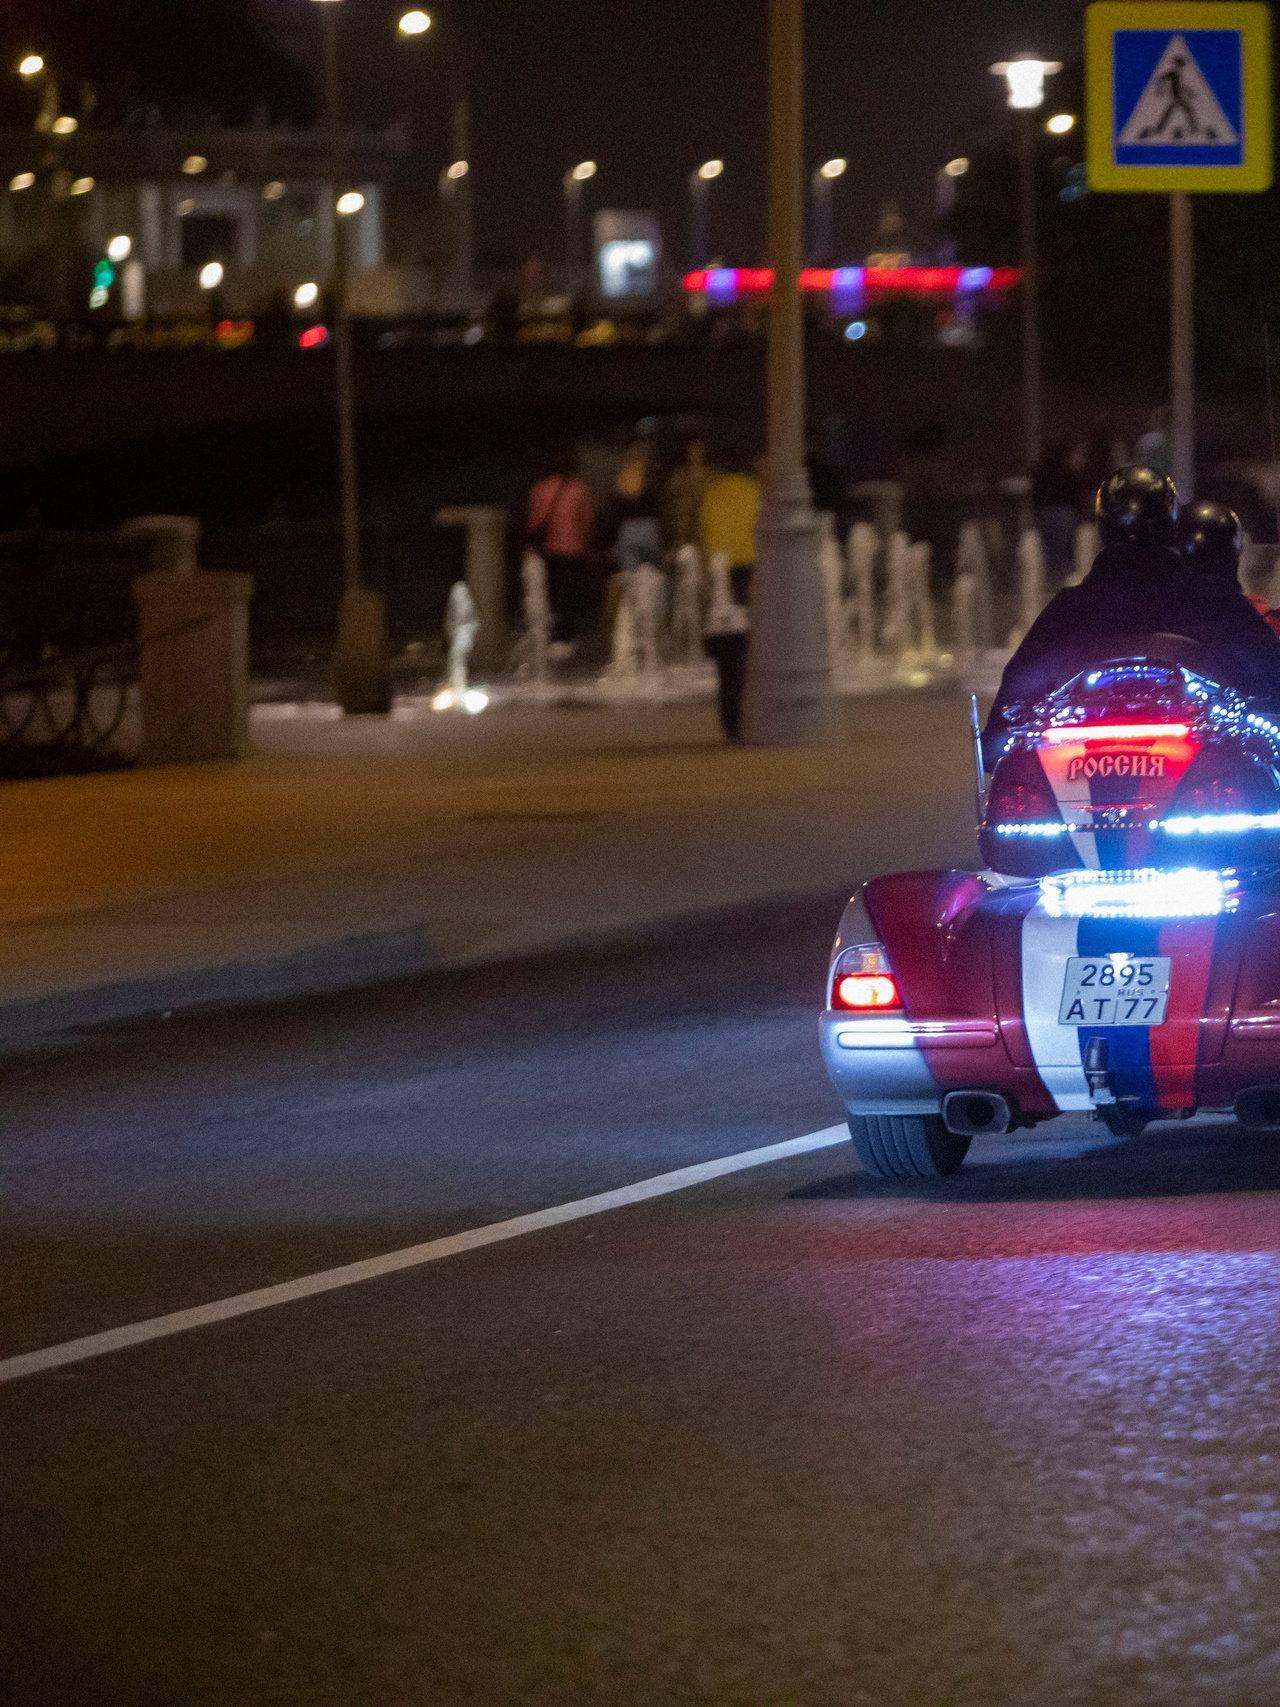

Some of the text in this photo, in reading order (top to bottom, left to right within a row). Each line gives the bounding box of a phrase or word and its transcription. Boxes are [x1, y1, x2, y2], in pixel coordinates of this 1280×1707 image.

[1069, 756, 1165, 779] РОССИЯ
[1081, 963, 1154, 986] 2895
[1117, 988, 1144, 996] RUS
[1124, 998, 1159, 1019] 77
